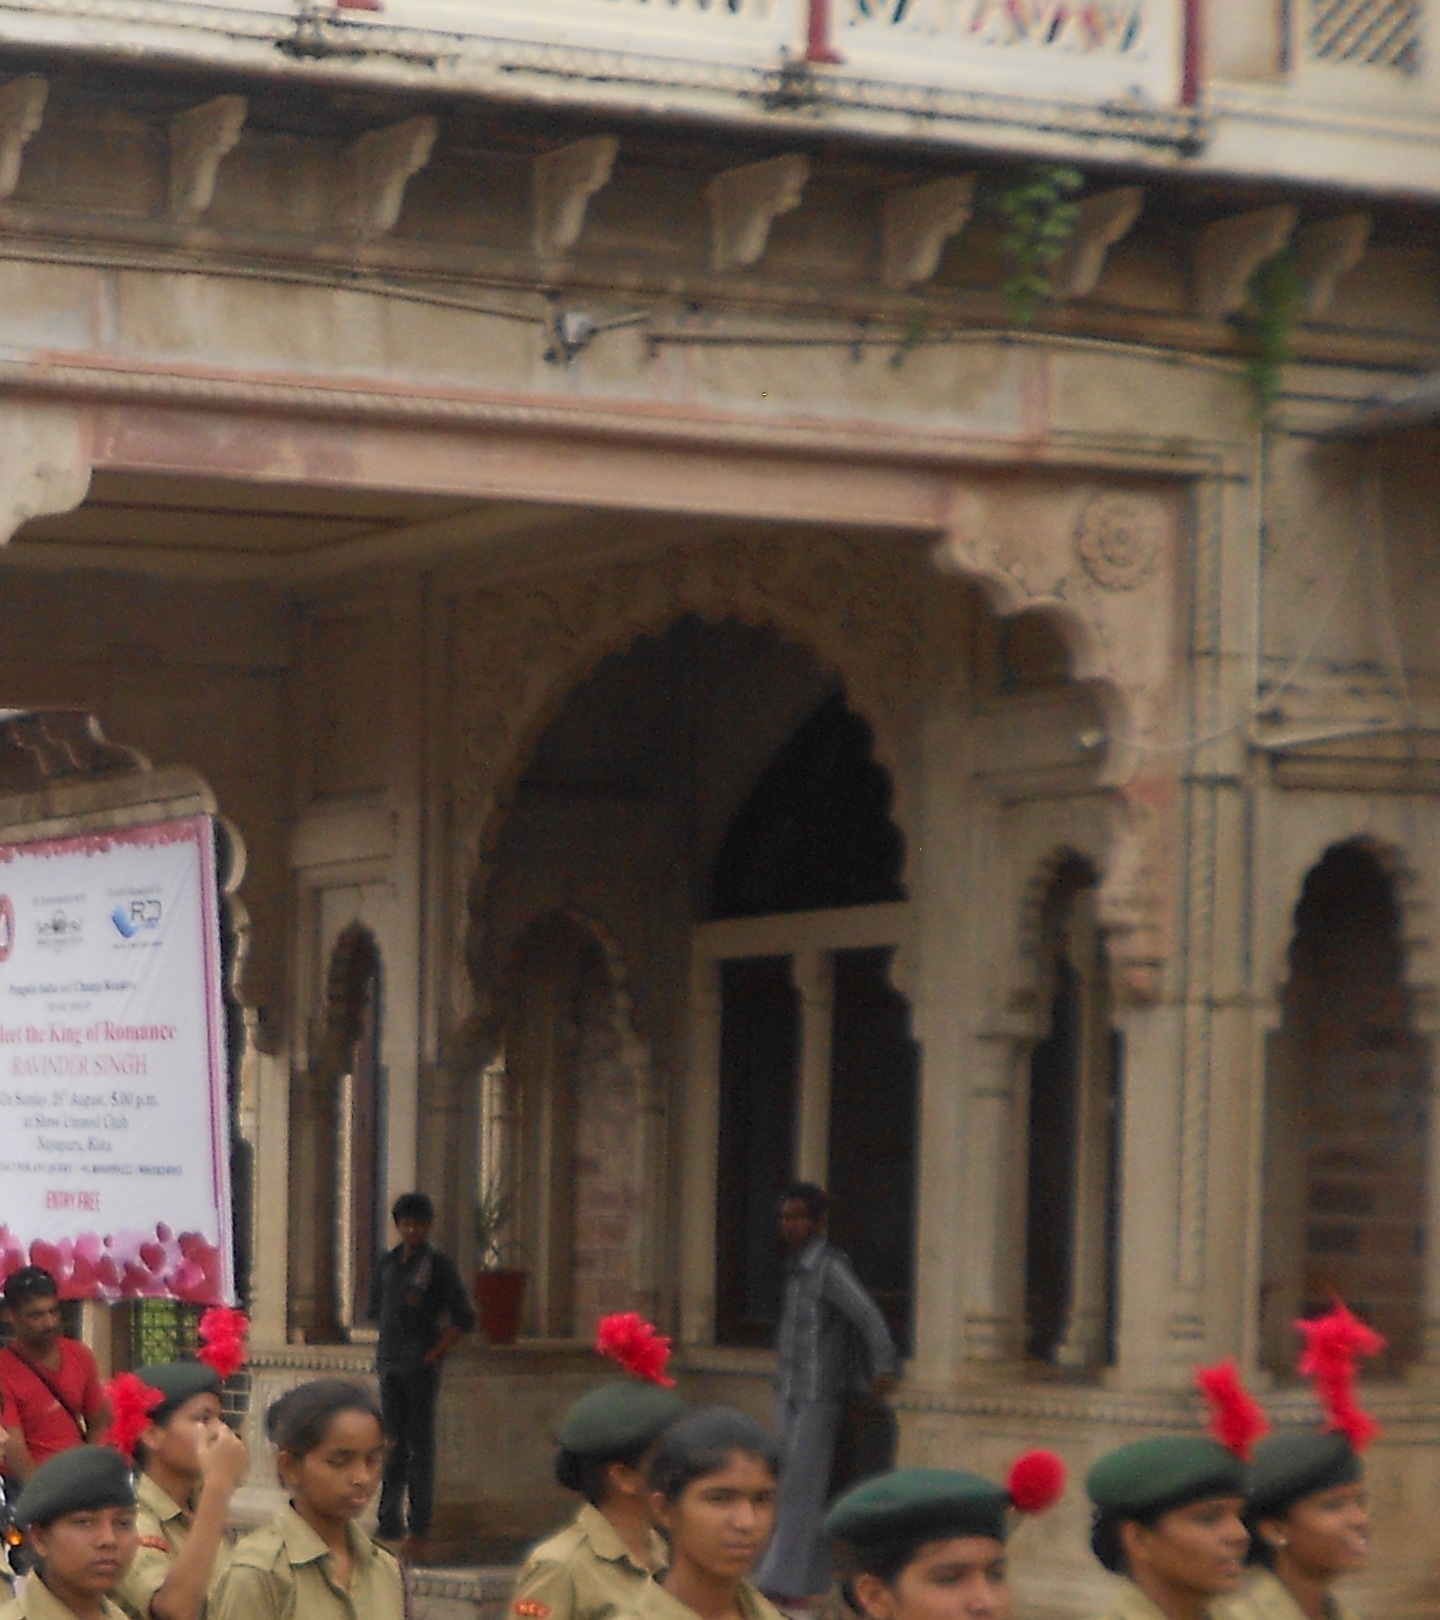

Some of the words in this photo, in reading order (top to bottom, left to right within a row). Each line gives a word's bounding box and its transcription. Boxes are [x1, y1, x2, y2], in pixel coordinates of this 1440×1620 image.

[50, 1022, 82, 1046] King
[86, 1021, 99, 1041] of
[105, 1019, 177, 1041] Romance
[13, 1053, 88, 1076] RAVINDER
[94, 1052, 148, 1075] SINGH
